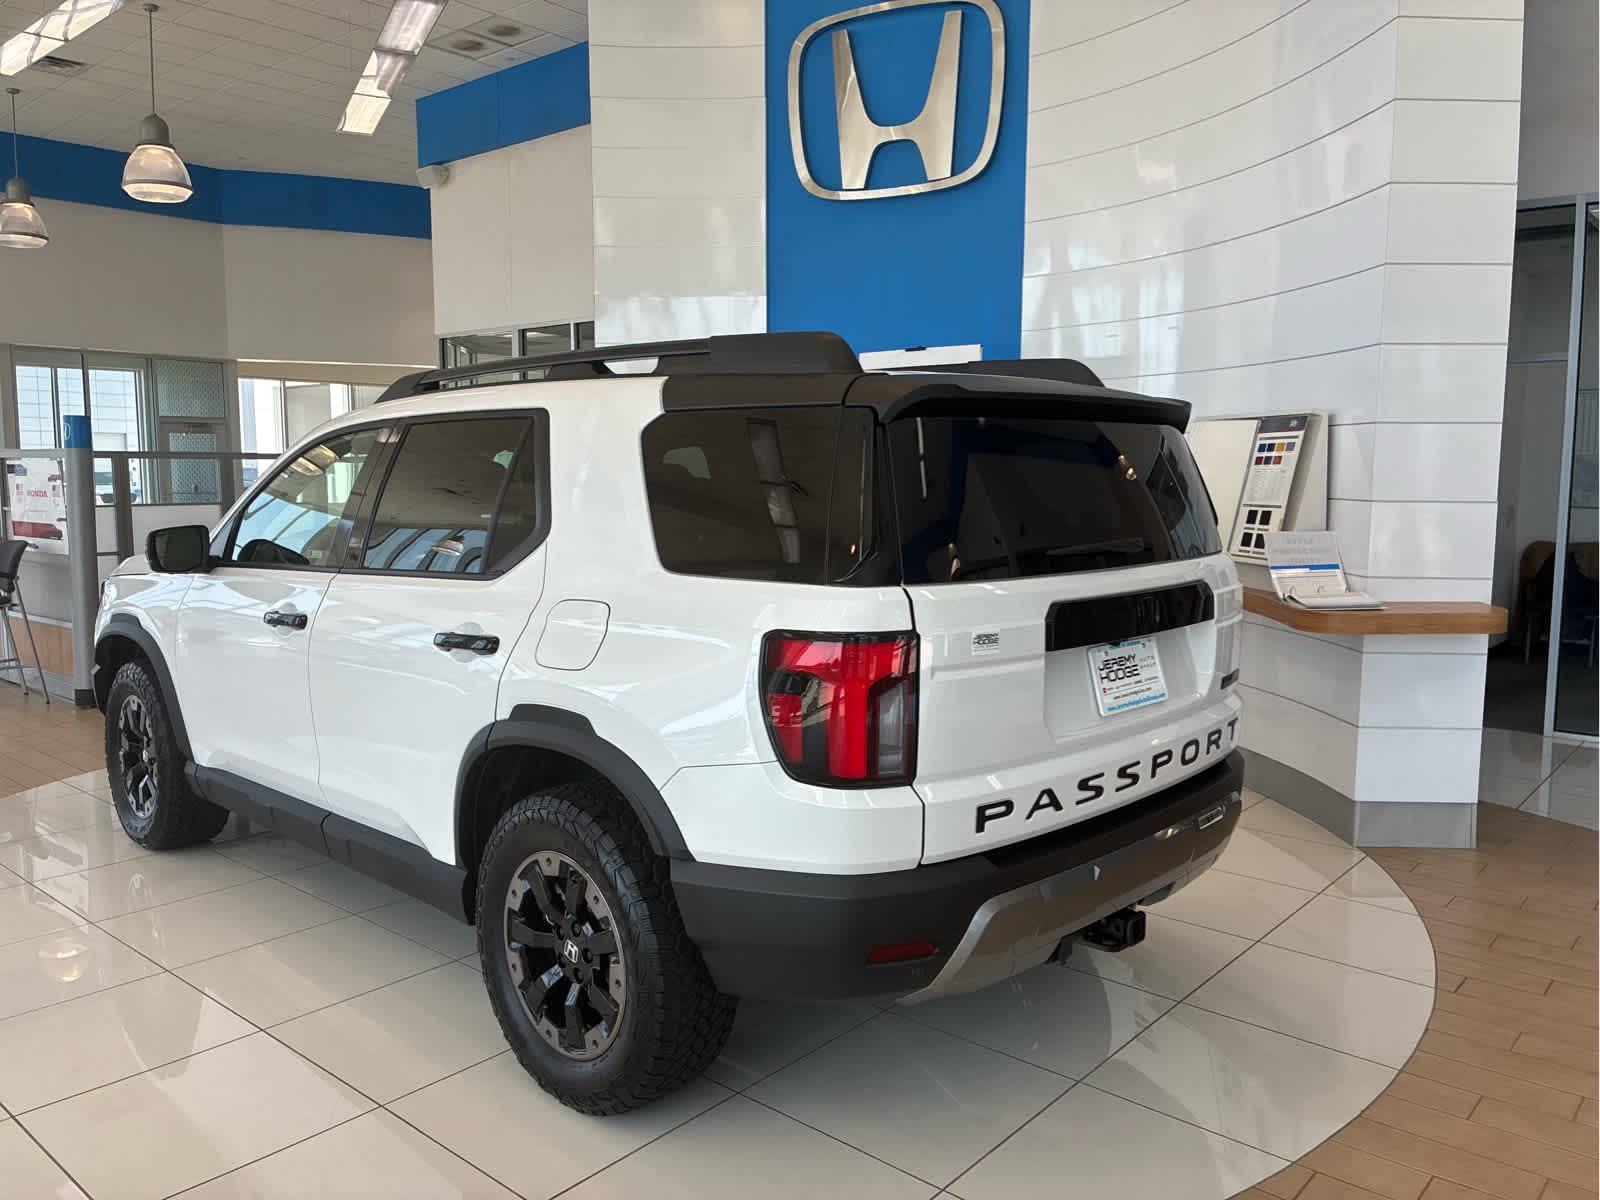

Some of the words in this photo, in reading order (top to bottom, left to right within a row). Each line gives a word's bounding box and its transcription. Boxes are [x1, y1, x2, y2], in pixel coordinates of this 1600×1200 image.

[1098, 653, 1136, 671] JEREMY
[1100, 664, 1140, 683] HODGE
[975, 717, 1239, 833] PASSPORT
